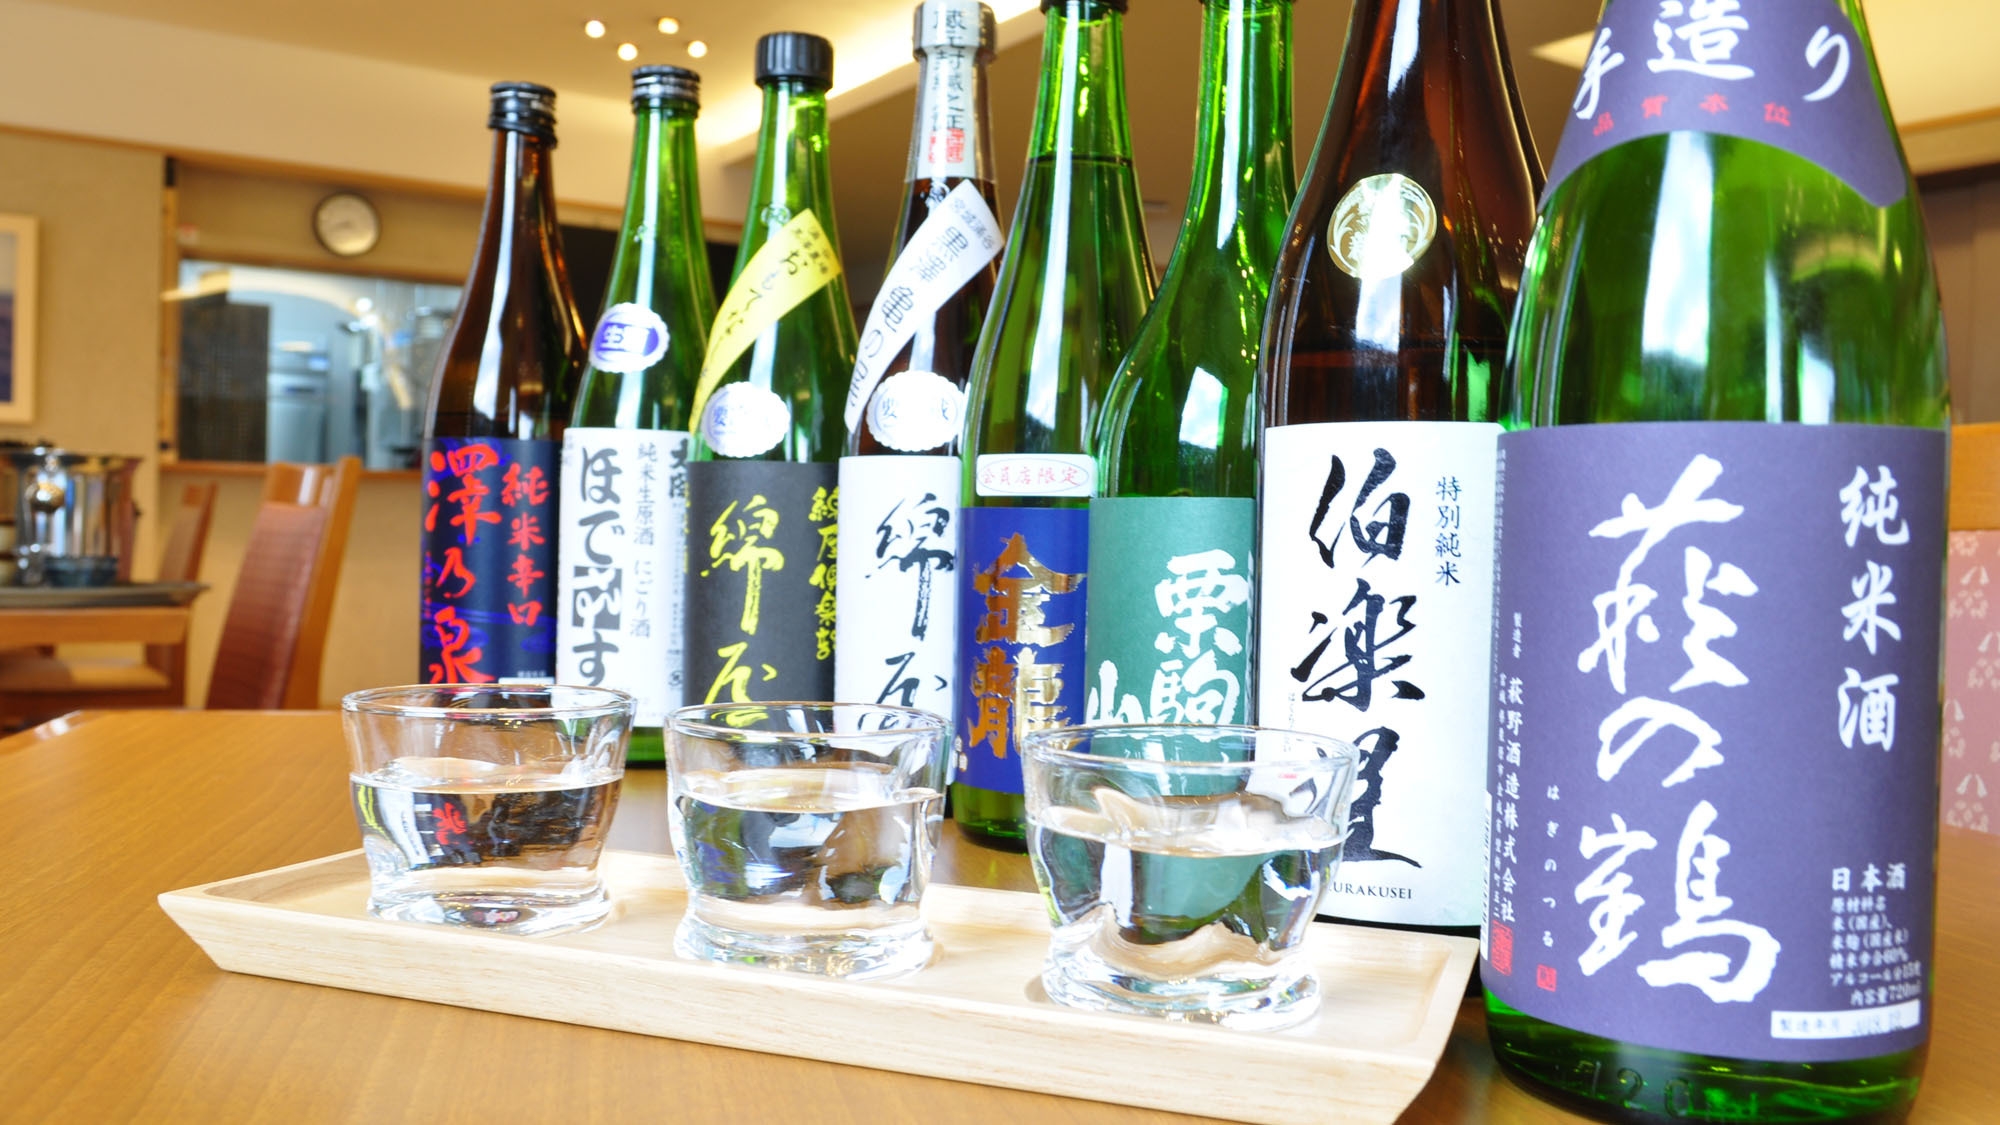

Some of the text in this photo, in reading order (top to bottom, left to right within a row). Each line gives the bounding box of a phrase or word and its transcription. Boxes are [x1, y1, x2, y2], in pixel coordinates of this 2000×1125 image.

[1573, 0, 1850, 119] 手造り
[1593, 93, 1791, 136] 品質本位
[501, 462, 550, 626] 純米辛口
[630, 442, 657, 639] 純米生原酒 にごり酒
[1434, 475, 1463, 587] 特別純米
[1837, 465, 1909, 751] 純米酒
[1499, 676, 1524, 923] 萩野酒造株式会社
[1574, 453, 1781, 1003] 萩の鶴
[1329, 881, 1413, 900] URAKUSEI
[1542, 784, 1561, 948] はぎのつる
[1831, 862, 1907, 893] 日本酒
